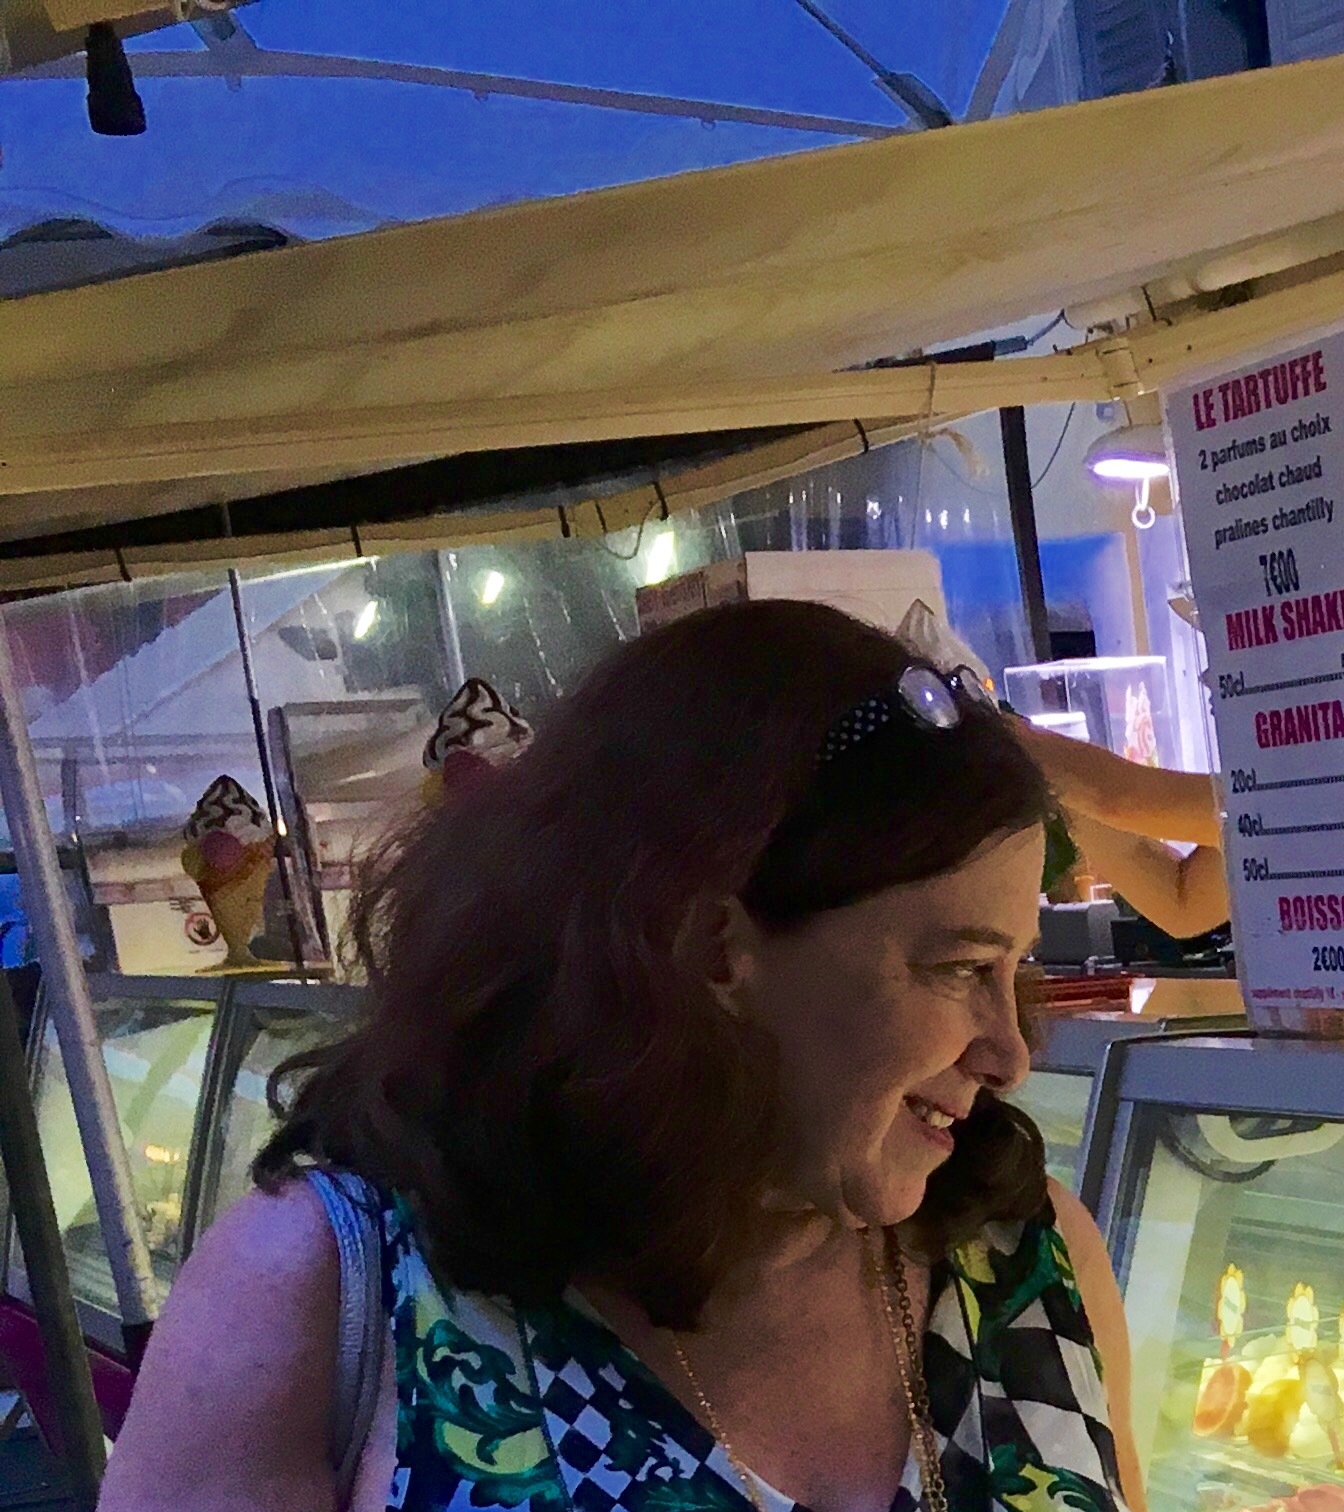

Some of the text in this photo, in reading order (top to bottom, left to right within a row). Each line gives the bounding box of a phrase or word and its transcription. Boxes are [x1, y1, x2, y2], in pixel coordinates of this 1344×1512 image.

[1192, 389, 1218, 432] LE
[1217, 350, 1327, 424] TARTUFFE
[1198, 412, 1333, 473] 2 parfums au choix
[1215, 455, 1323, 506] chocolat chaud
[1213, 495, 1335, 550] pralines chantilly
[1259, 548, 1301, 598] 7€00
[1226, 604, 1279, 652] MILK
